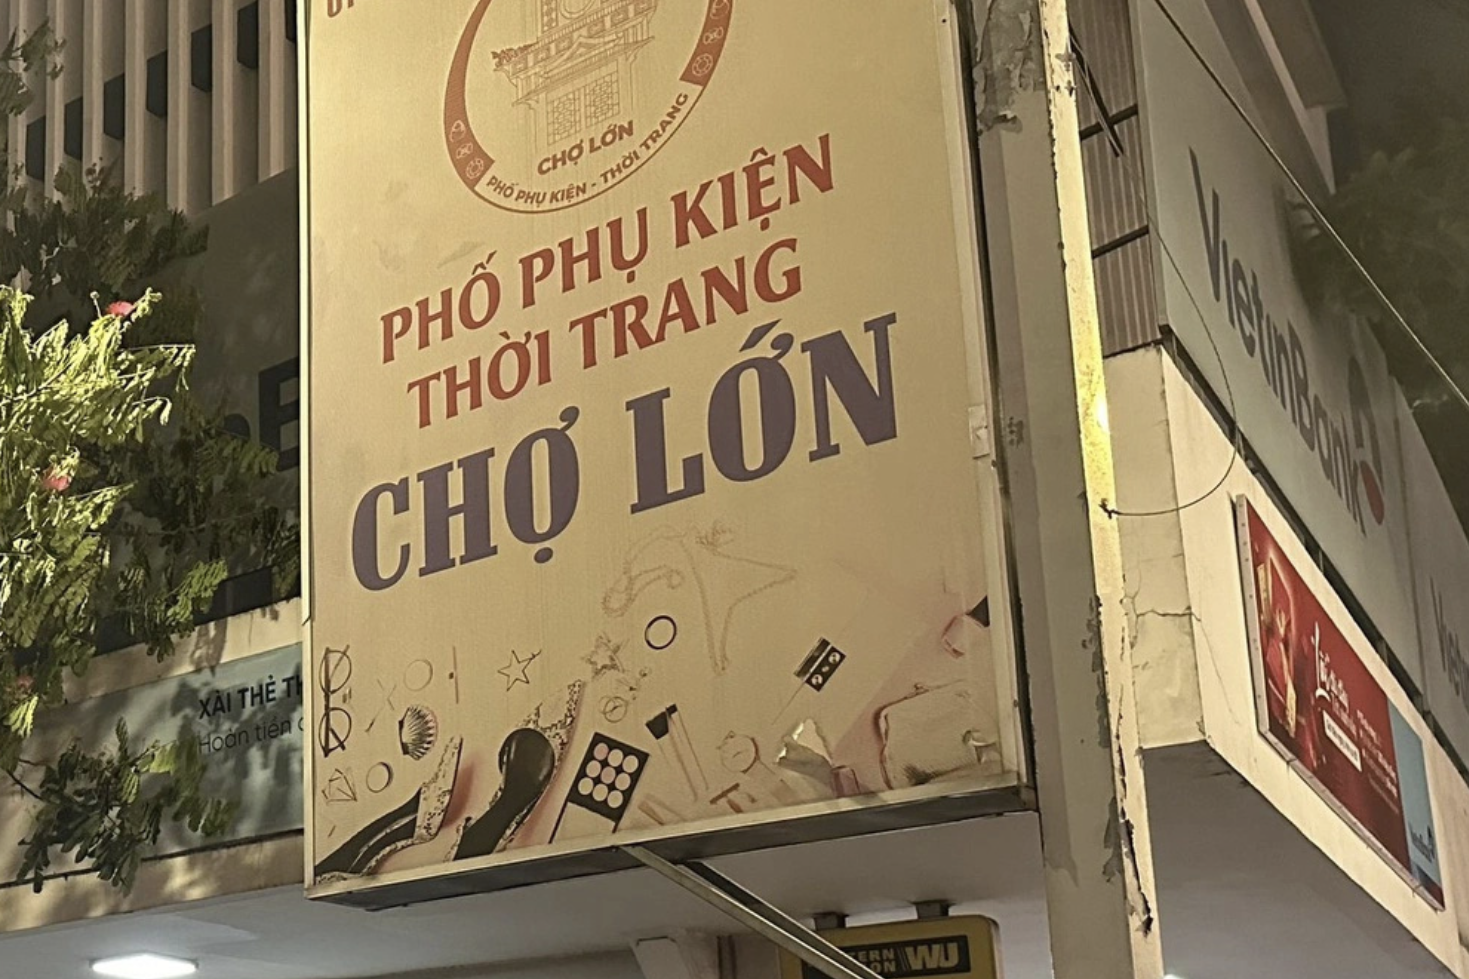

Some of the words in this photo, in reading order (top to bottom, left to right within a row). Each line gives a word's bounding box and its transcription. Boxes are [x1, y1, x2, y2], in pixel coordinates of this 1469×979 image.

[486, 174, 520, 198] PHỐ
[514, 190, 548, 208] PHỤ
[548, 182, 588, 205] KIỆN
[599, 148, 641, 186] THỜI
[638, 91, 690, 152] TRANG
[536, 137, 584, 174] CHỢ
[588, 119, 634, 155] LỚN
[379, 250, 502, 365] PHỐ
[517, 206, 650, 311] PHỤ
[670, 132, 835, 250] KIỆN
[406, 328, 553, 430] THỜI
[567, 236, 804, 370] TRANG
[1189, 146, 1367, 539] VietinBank
[349, 404, 583, 593] CHỢ
[624, 310, 899, 517] LỚN
[198, 690, 233, 720] XÀI
[237, 674, 278, 710] THẺ
[199, 727, 250, 755] Hoàn
[254, 715, 293, 746] tiền
[904, 941, 960, 971] WU
